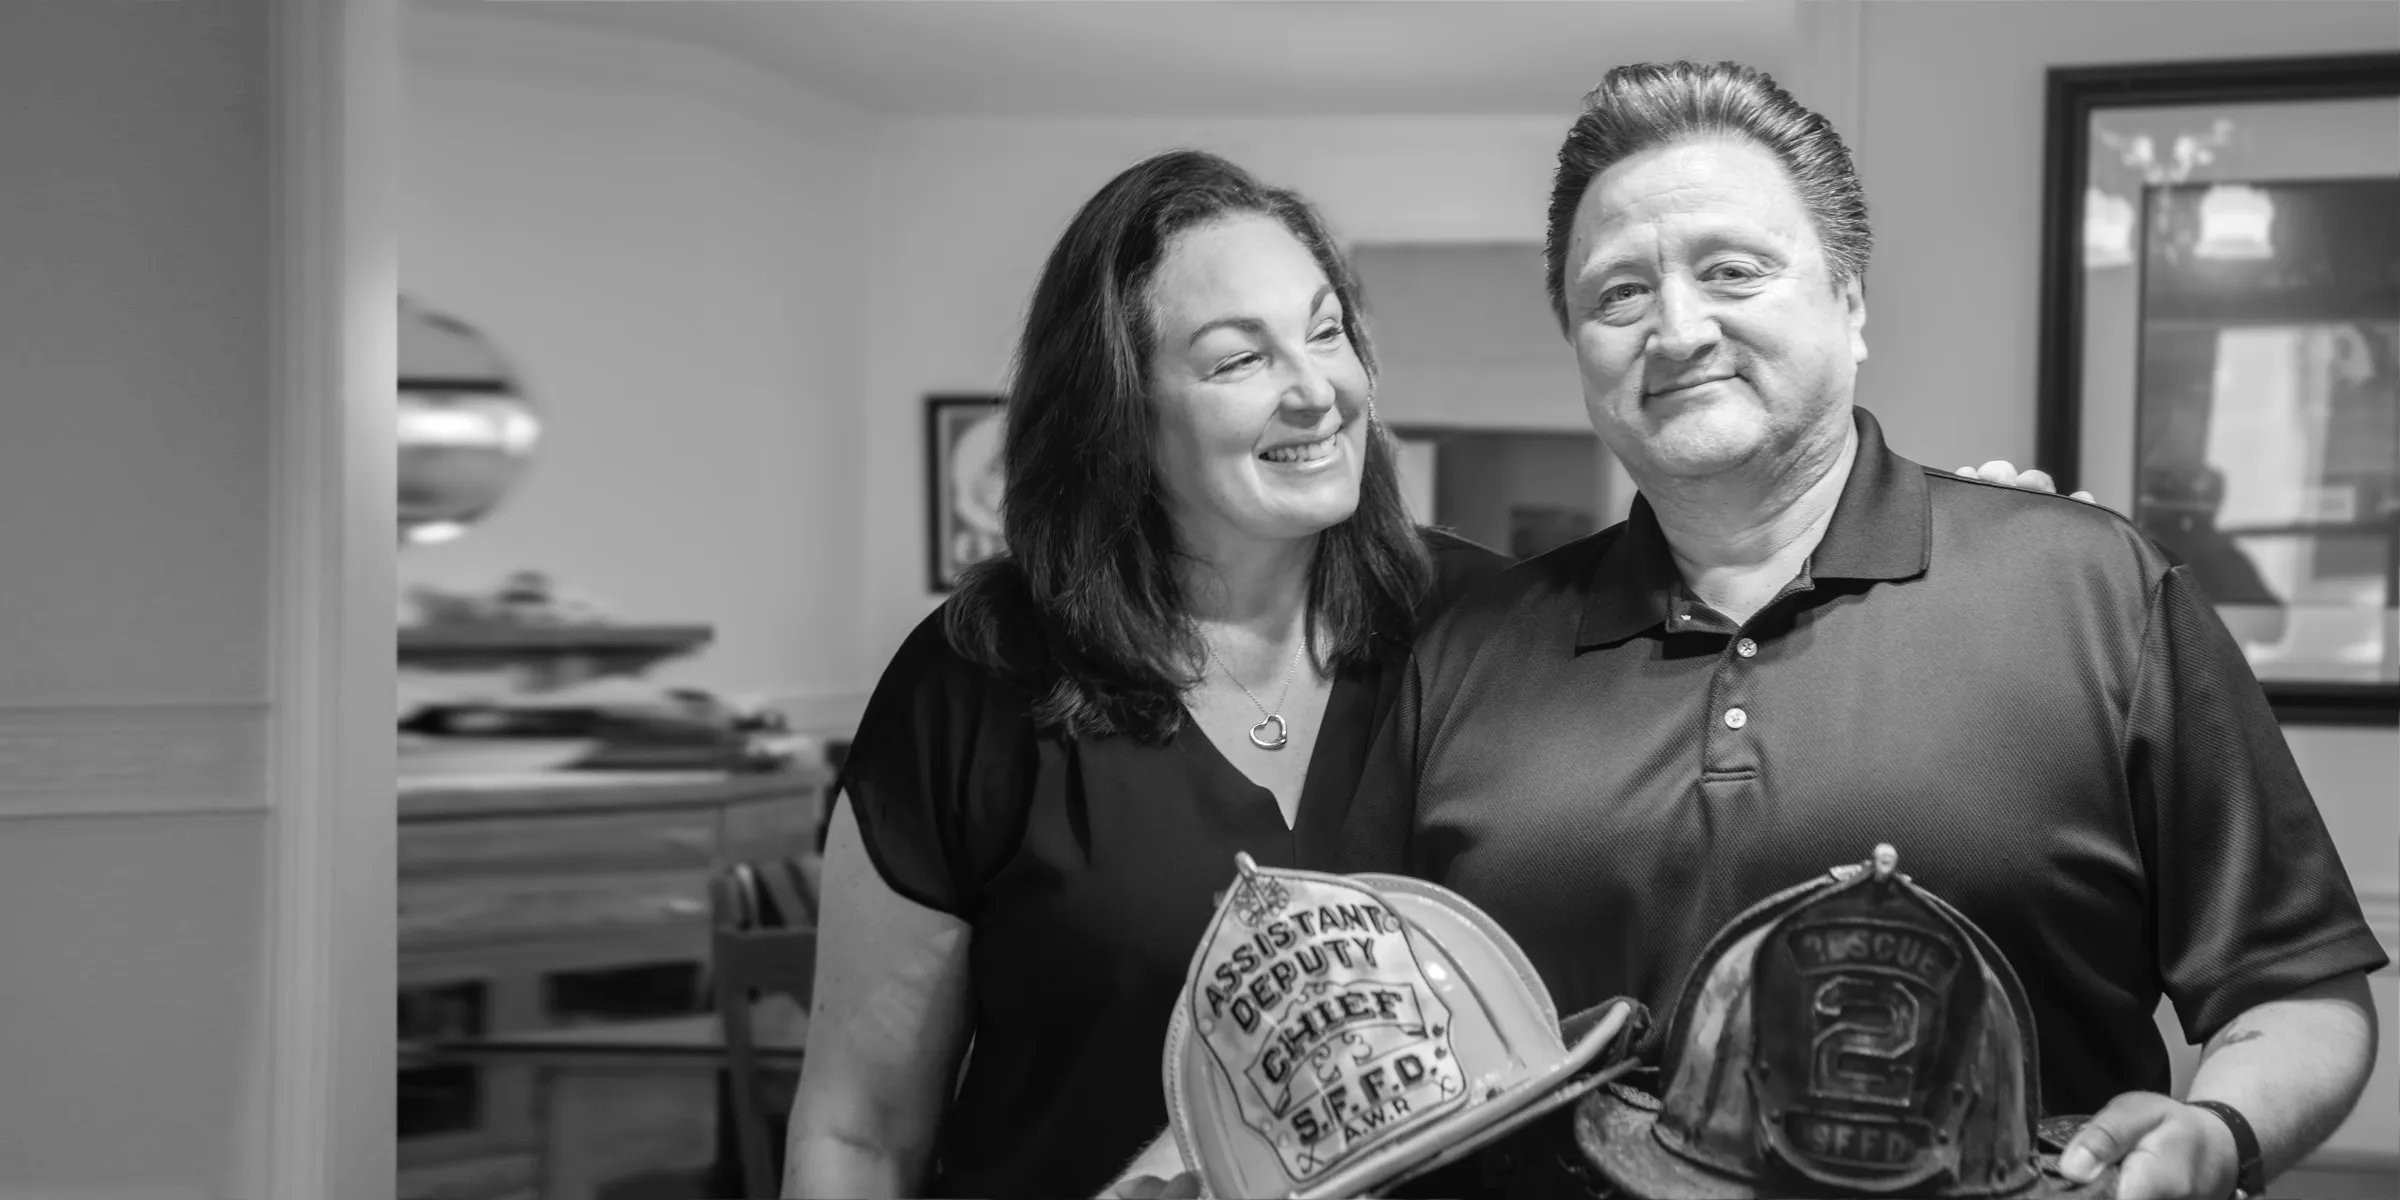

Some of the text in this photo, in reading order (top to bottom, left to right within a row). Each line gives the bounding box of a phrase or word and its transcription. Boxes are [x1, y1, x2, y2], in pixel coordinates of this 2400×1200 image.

[1205, 904, 1384, 1018] ASSISTANT
[1230, 937, 1377, 1034] DEPUTY
[1262, 990, 1403, 1084] CHIEF
[1808, 975, 1920, 1107] 2
